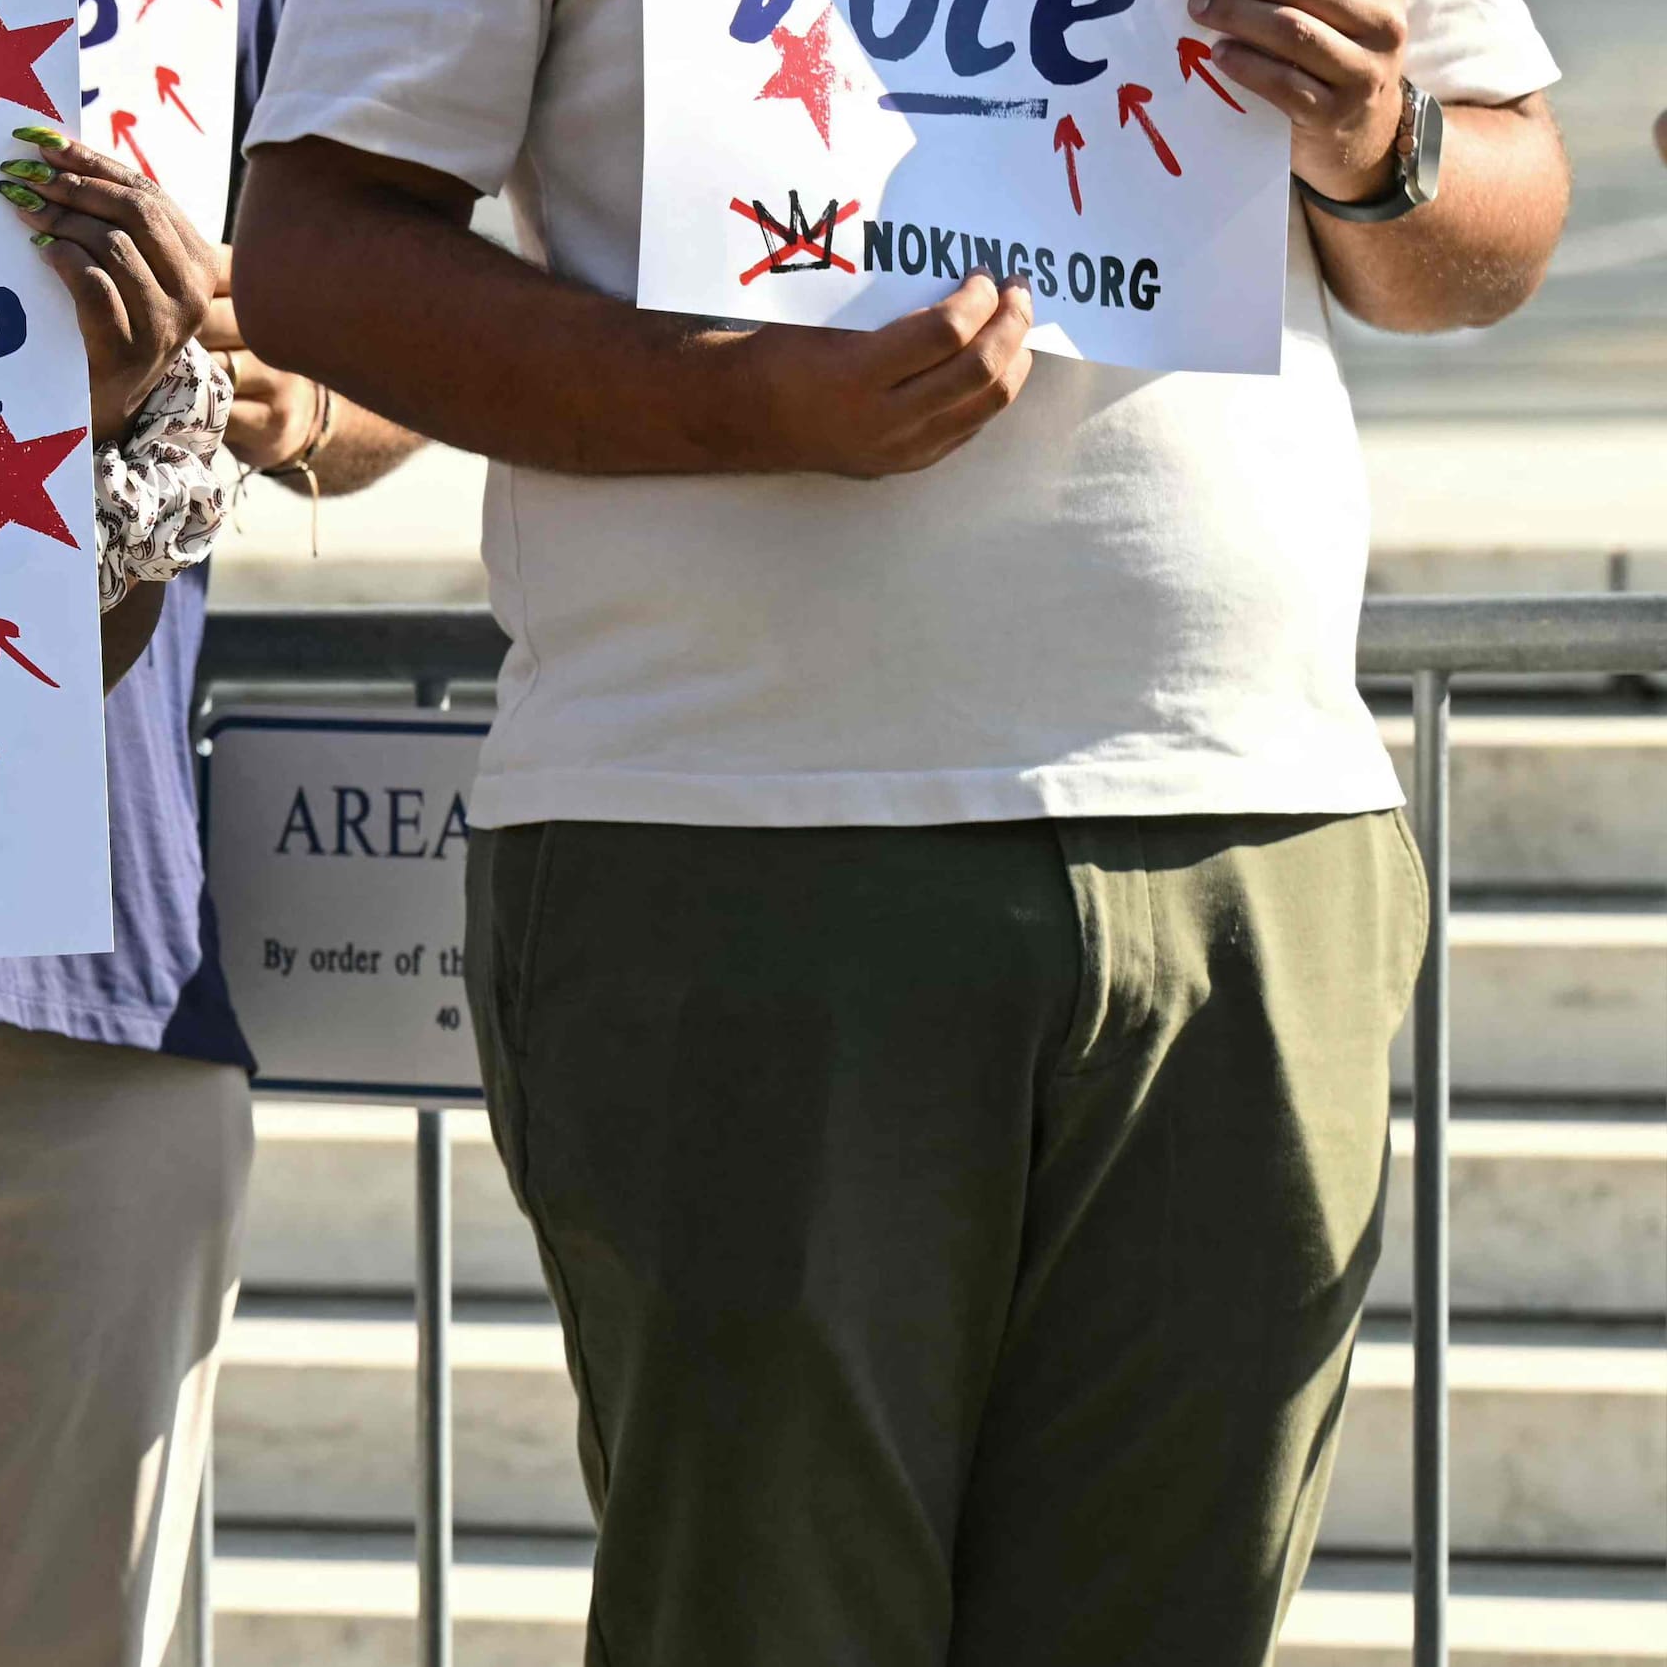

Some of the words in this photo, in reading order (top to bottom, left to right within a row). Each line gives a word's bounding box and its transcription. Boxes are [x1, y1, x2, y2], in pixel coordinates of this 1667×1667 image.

[863, 220, 1161, 312] NOKINGS.ORG
[274, 786, 470, 860] AREA
[263, 938, 297, 977] By
[310, 943, 382, 975] order
[394, 945, 425, 976] of
[439, 947, 465, 977] th
